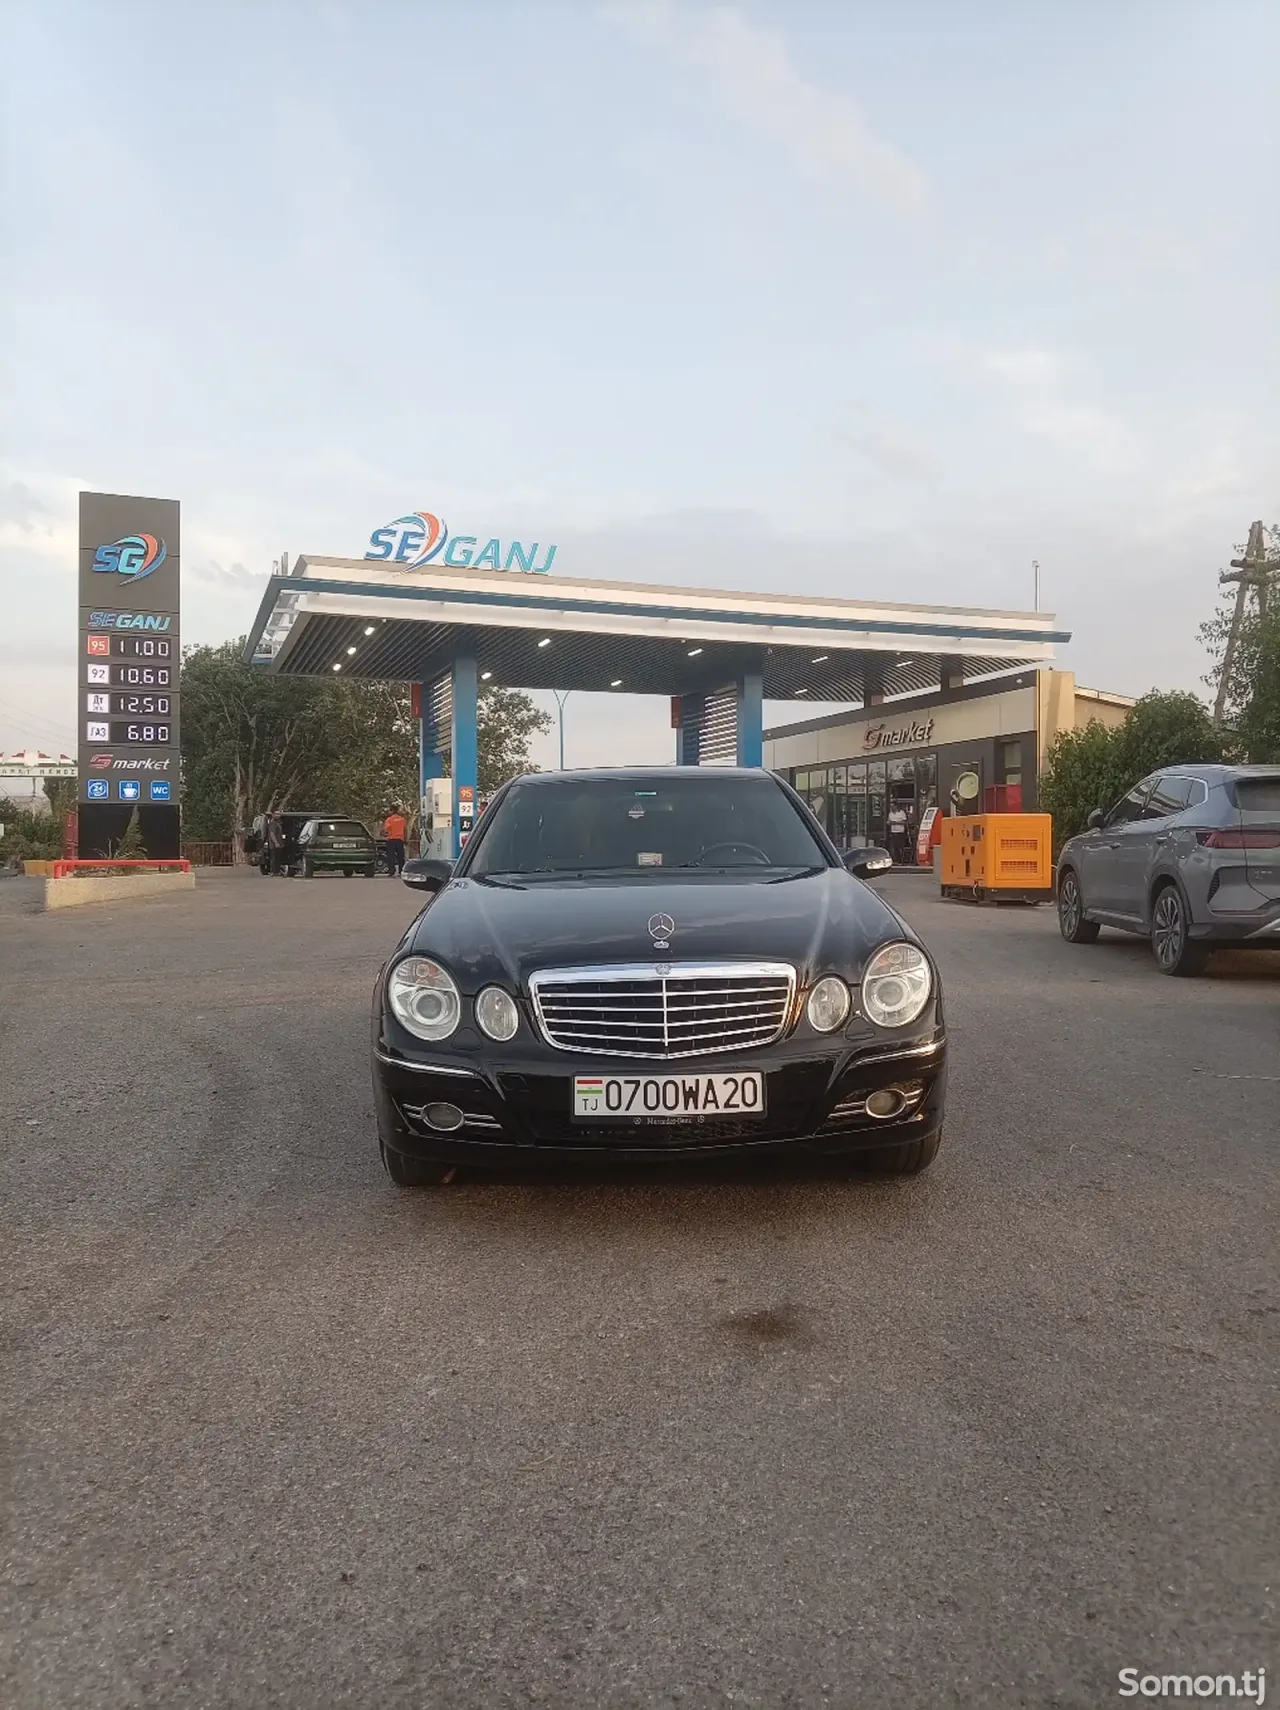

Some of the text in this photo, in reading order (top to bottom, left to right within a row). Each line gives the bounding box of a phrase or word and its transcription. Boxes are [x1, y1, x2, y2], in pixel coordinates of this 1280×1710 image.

[92, 545, 145, 574] SG
[87, 612, 171, 631] SEGANJ
[91, 640, 169, 656] 95 11.00
[91, 668, 169, 685] 92 10.60
[120, 697, 169, 713] 12.50
[90, 725, 169, 741] ГАЗ 6.80
[461, 789, 472, 799] 95
[461, 805, 471, 813] 92
[582, 1077, 758, 1112] TJ 0700WA20
